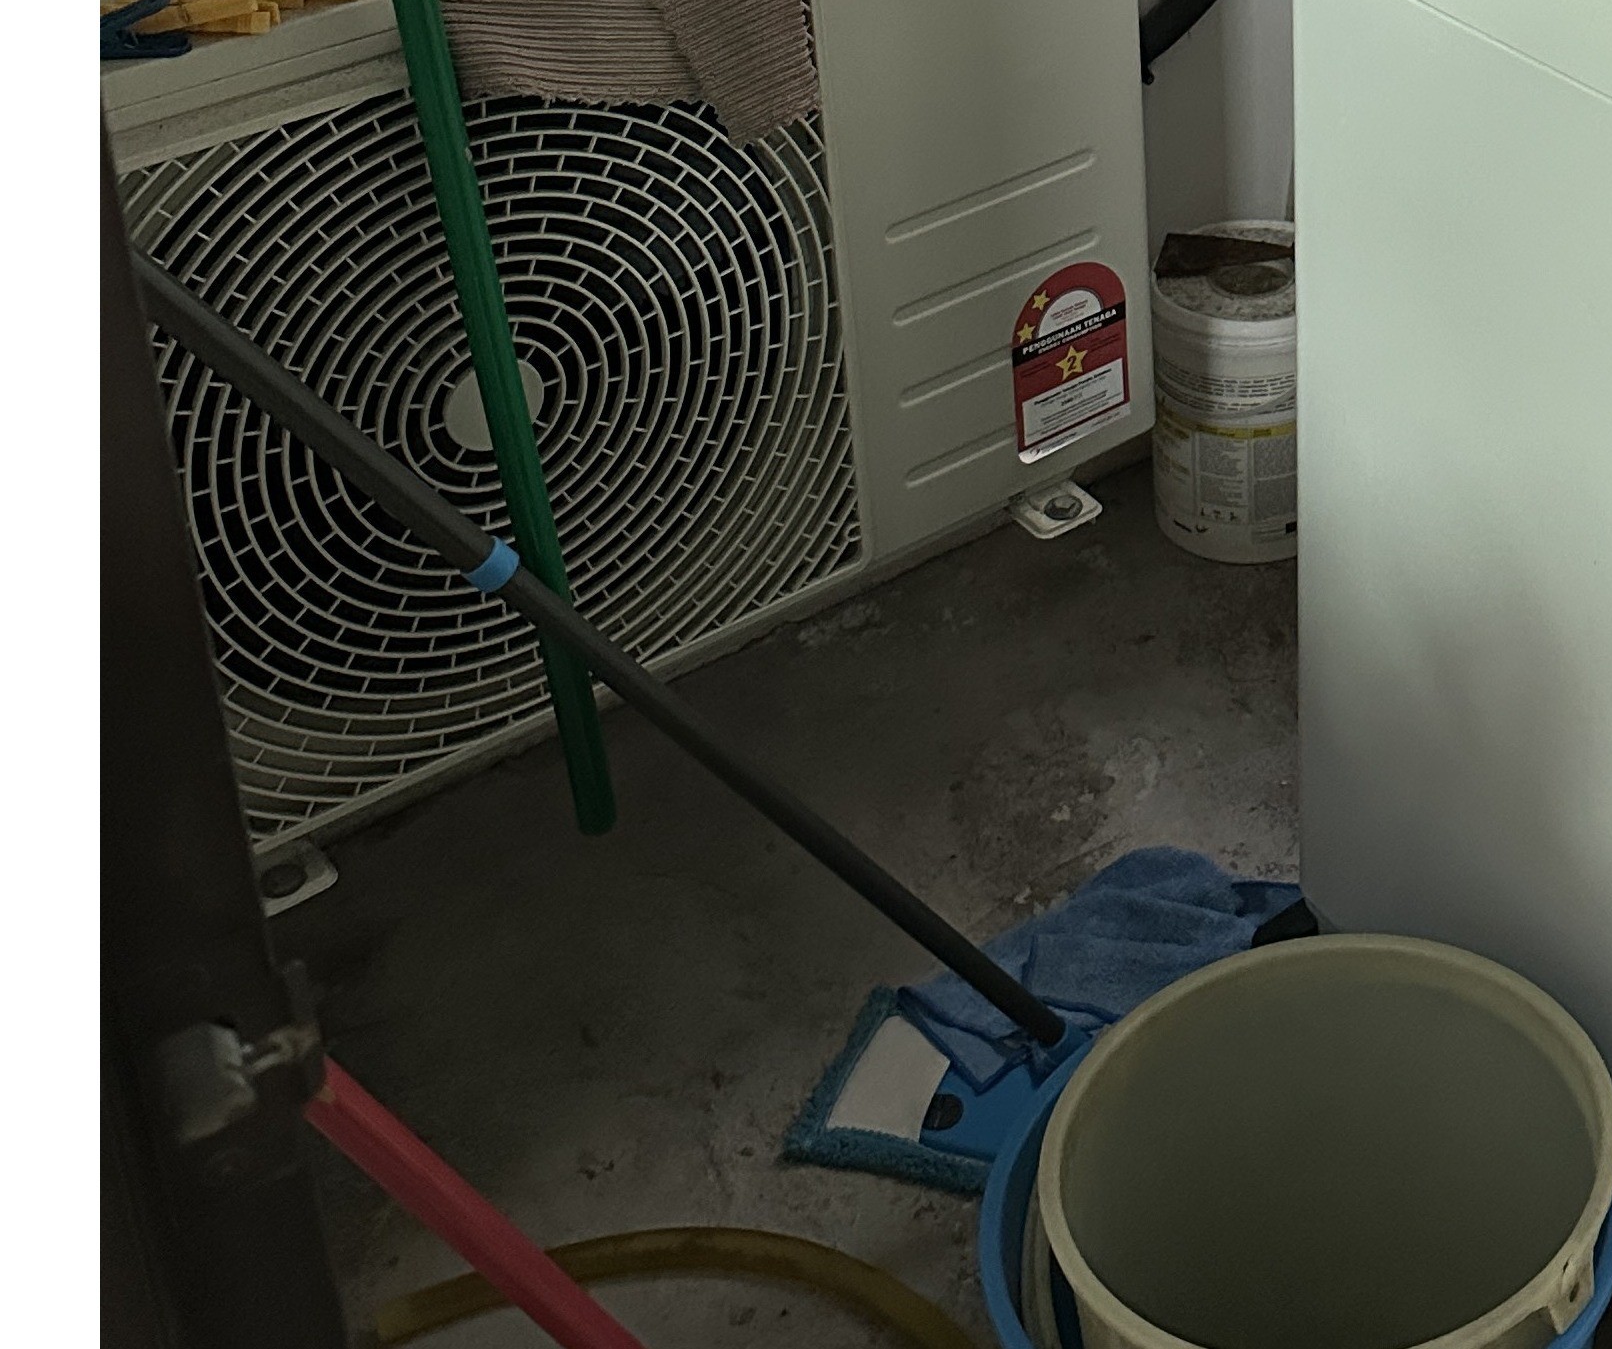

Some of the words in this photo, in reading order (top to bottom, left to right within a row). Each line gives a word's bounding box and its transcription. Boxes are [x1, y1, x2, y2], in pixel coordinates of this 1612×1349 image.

[1022, 323, 1082, 355] PENGGUNAAN
[1083, 309, 1117, 328] TENAGA
[1066, 355, 1077, 371] 2
